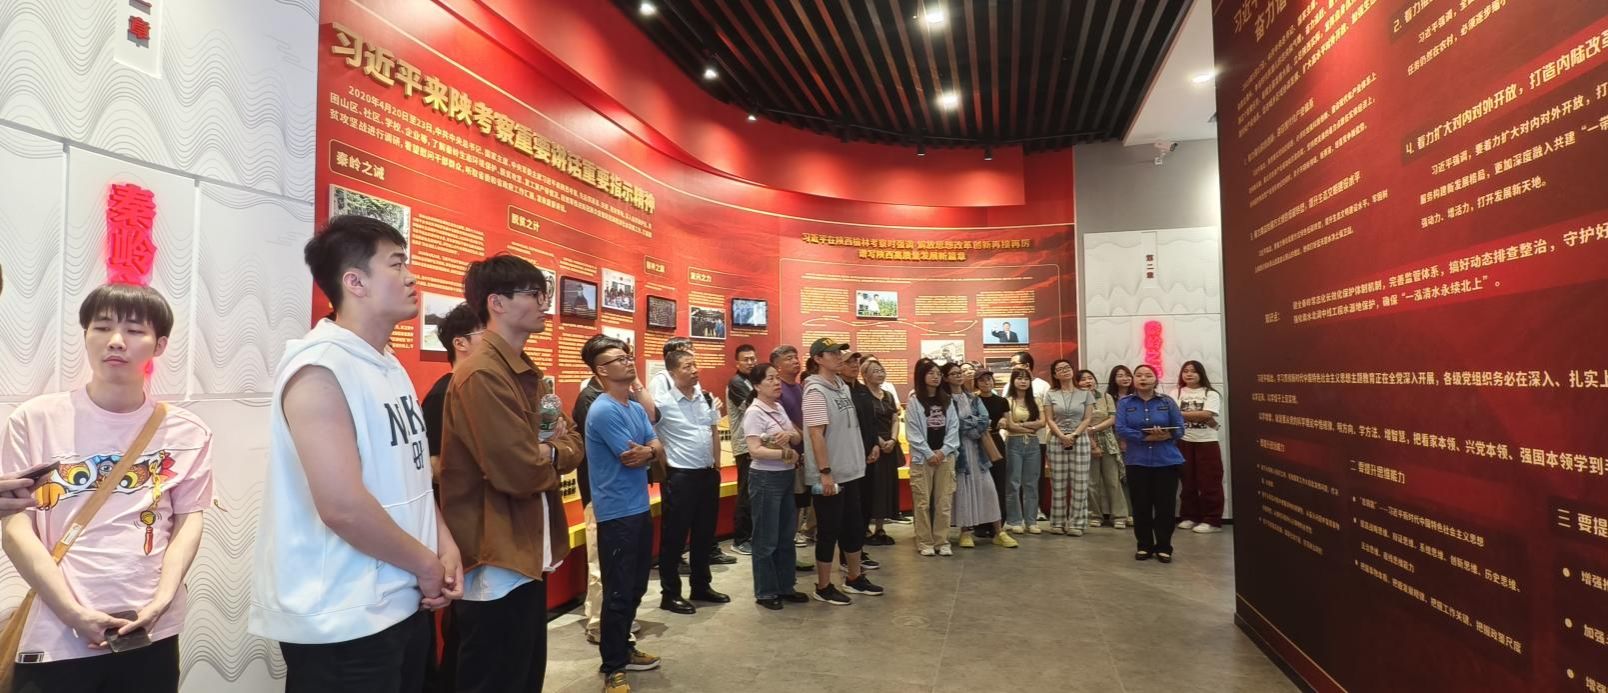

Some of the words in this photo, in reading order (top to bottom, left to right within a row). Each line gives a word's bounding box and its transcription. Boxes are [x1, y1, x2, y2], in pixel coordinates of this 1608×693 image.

[331, 22, 656, 214] 习近平来陕考察重要讲话重要指示精神
